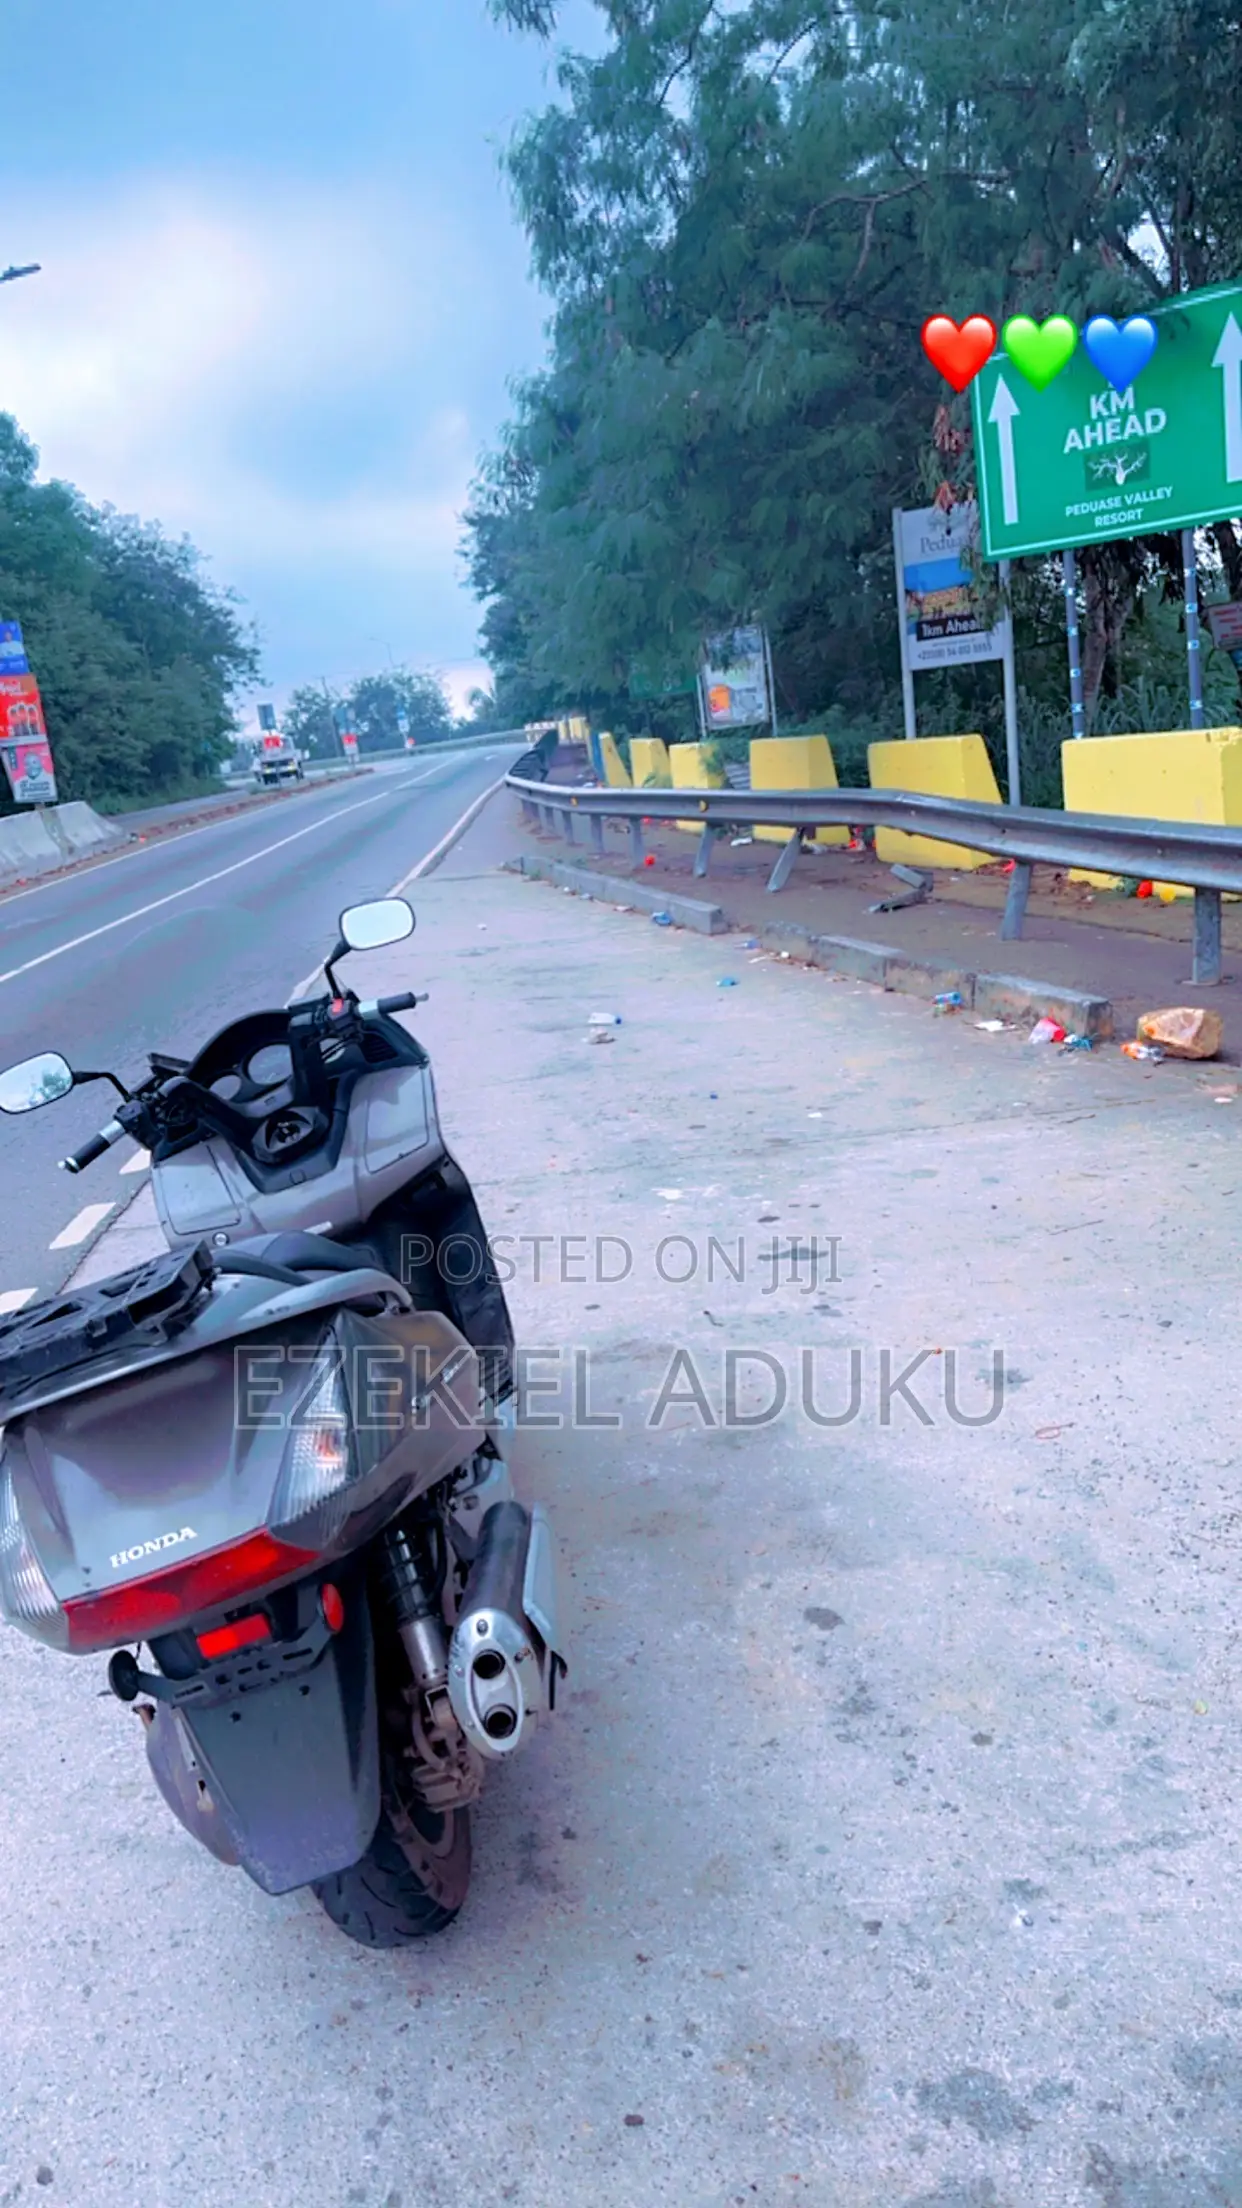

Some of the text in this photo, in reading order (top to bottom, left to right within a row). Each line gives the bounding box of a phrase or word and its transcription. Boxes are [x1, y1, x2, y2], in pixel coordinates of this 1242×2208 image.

[1089, 384, 1135, 420] KM
[1063, 407, 1167, 454] AHEAD
[1065, 485, 1173, 517] PEDUASE VALLEY
[1094, 508, 1144, 527] RESORT
[945, 618, 982, 635] Ahea
[110, 1526, 197, 1568] HONDA
